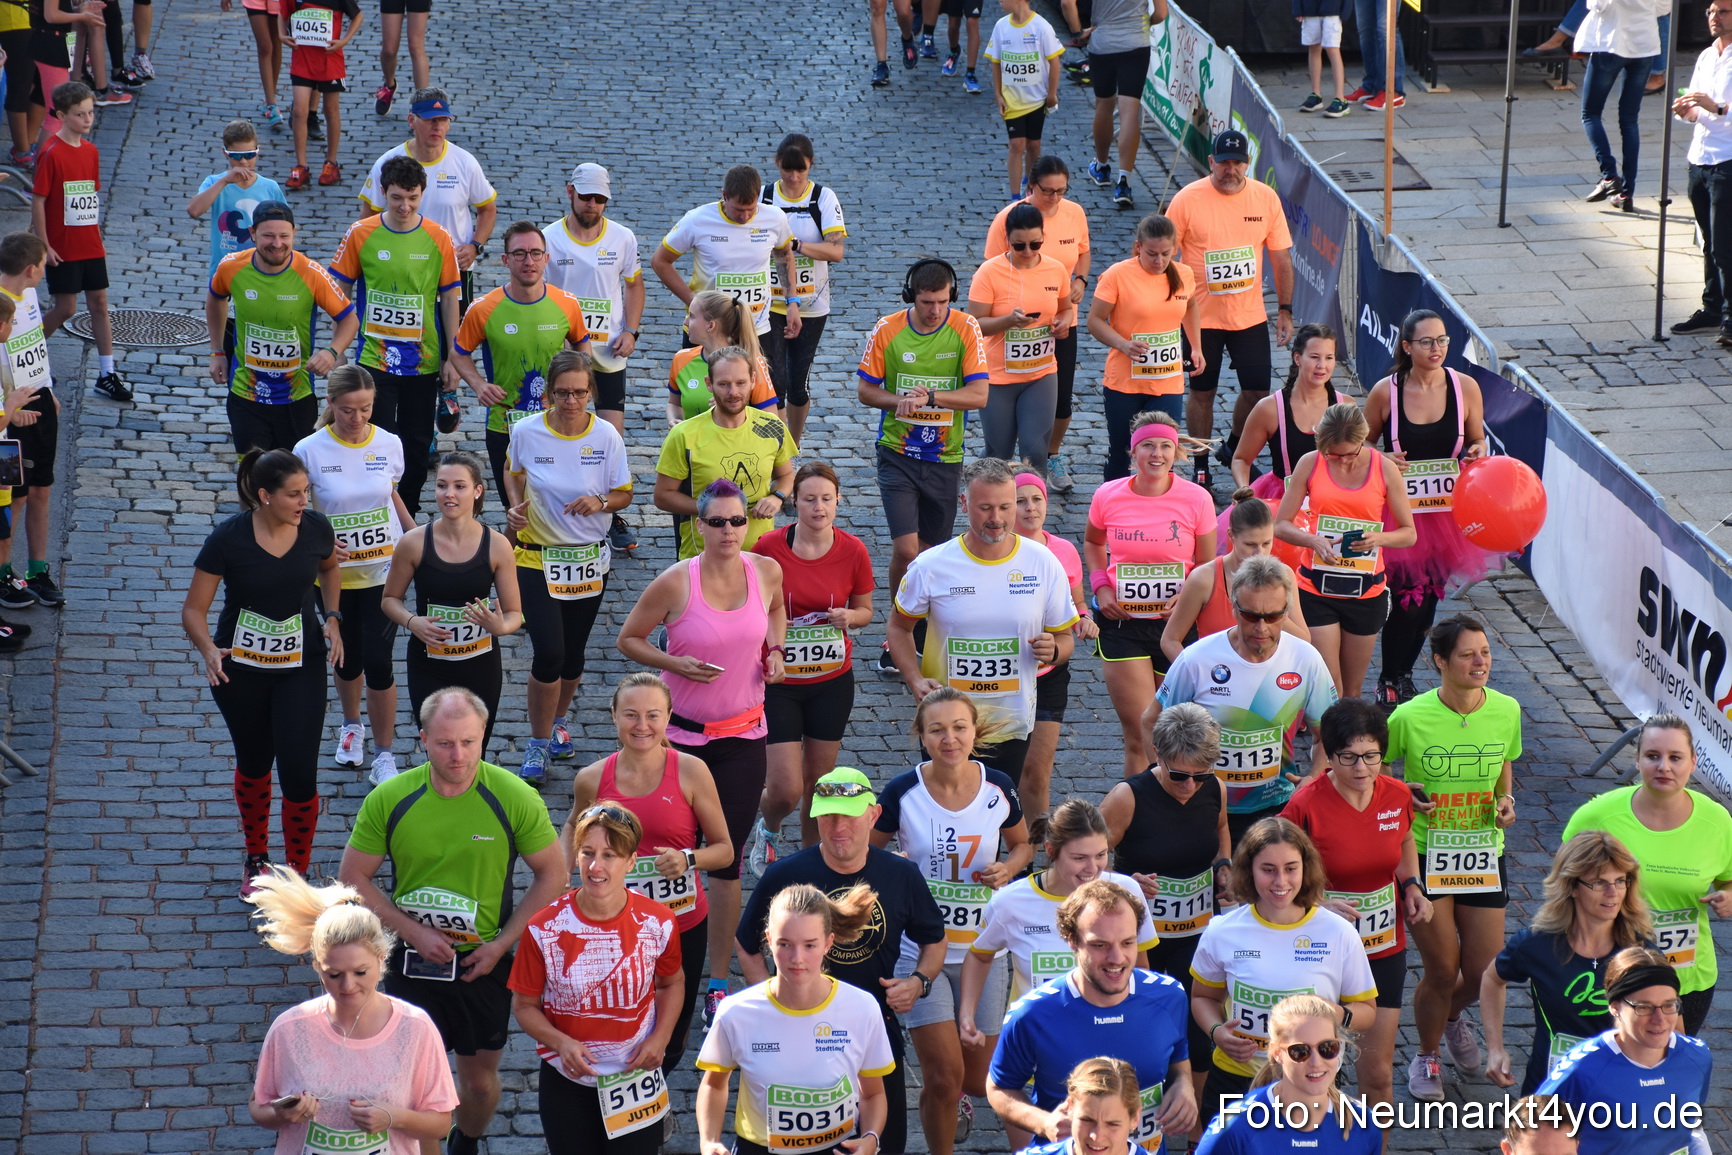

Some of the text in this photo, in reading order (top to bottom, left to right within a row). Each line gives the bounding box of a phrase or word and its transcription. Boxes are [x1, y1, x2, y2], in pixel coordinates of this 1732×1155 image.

[294, 10, 330, 20] BOCK
[296, 21, 327, 33] 4045
[1005, 52, 1035, 61] BOCK
[1005, 64, 1036, 75] 4038
[68, 183, 95, 194] BOC
[71, 197, 98, 210] 4025
[1208, 248, 1251, 263] BOCK
[1212, 263, 1251, 280] 5241
[720, 274, 763, 285] BOCK
[1222, 281, 1245, 290] DAVID
[372, 294, 418, 308] BOCK
[722, 288, 762, 302] 215
[373, 307, 417, 326] 5253
[10, 331, 41, 350] BOCK
[248, 325, 297, 343] BOCK
[1009, 327, 1051, 340] BOCK
[17, 344, 45, 368] 4016
[250, 342, 295, 358] 5142
[1011, 341, 1050, 357] 5287
[1139, 347, 1177, 363] 5160
[256, 358, 290, 368] VITALIJ
[1142, 365, 1174, 374] BETTINA
[903, 378, 950, 390] BOCK
[365, 453, 375, 461] 20
[581, 447, 592, 455] 20
[1407, 461, 1453, 475] BOCK
[1407, 477, 1454, 495] 5110
[1418, 499, 1447, 507] ALINA
[333, 510, 385, 528] BOCK
[1323, 519, 1375, 532] BOCK
[336, 527, 385, 549] 5165
[1115, 528, 1157, 542] läuft...
[349, 549, 384, 560] LAUDIA
[548, 544, 596, 561] BOCK
[551, 561, 595, 581] 5116
[1009, 573, 1022, 582] 20
[1122, 565, 1179, 578] BOCK
[555, 584, 592, 594] CLAUDIA
[950, 586, 976, 594] BOCK
[1125, 583, 1177, 599] 5015
[1123, 604, 1165, 612] CHRISTI
[244, 613, 297, 634] BOCK
[786, 628, 836, 641] BOCK
[1637, 566, 1727, 704] swn
[241, 632, 296, 653] 5128
[443, 643, 477, 654] SARAH
[953, 640, 1013, 653] BOCK
[243, 652, 291, 663] KATHRIN
[785, 645, 838, 663] 5194
[956, 658, 1013, 678] 5233
[969, 681, 999, 691] JÖRG
[1279, 675, 1300, 686] Hervis
[1636, 639, 1732, 757] stadtwerke neumar
[1220, 730, 1275, 746] BOCK
[1216, 747, 1274, 768] 5113
[1421, 743, 1505, 777] OPF
[1227, 771, 1263, 780] PETER
[1430, 791, 1493, 808] MERZ
[1377, 807, 1402, 820] Lauftreff
[1430, 807, 1493, 820] PREMIUM
[1379, 821, 1400, 832] Parsberg
[1435, 833, 1491, 846] BOCK
[937, 837, 945, 863] LAUF
[930, 855, 938, 878] TADT
[1435, 852, 1490, 871] 5103
[1158, 877, 1208, 895] BOCK
[1440, 876, 1484, 886] MARION
[931, 887, 985, 900] BOCK
[403, 891, 469, 911] BOCK
[1152, 893, 1205, 919] 5111
[943, 905, 982, 926] 281
[1164, 921, 1196, 932] LYDIA
[1296, 939, 1311, 948] 20
[1240, 986, 1285, 1006] BOC
[1094, 1014, 1124, 1025] hummel
[816, 1026, 831, 1037] 20
[752, 1043, 780, 1051] BOCK
[1640, 1077, 1665, 1087] hummel
[610, 1069, 661, 1111] 5199
[776, 1082, 847, 1105] BOCK
[628, 1102, 661, 1122] JUTTA
[778, 1103, 845, 1131] 5031
[313, 1128, 383, 1149] BOCK
[782, 1127, 845, 1147] VICTORIA
[1292, 1138, 1318, 1148] hummel
